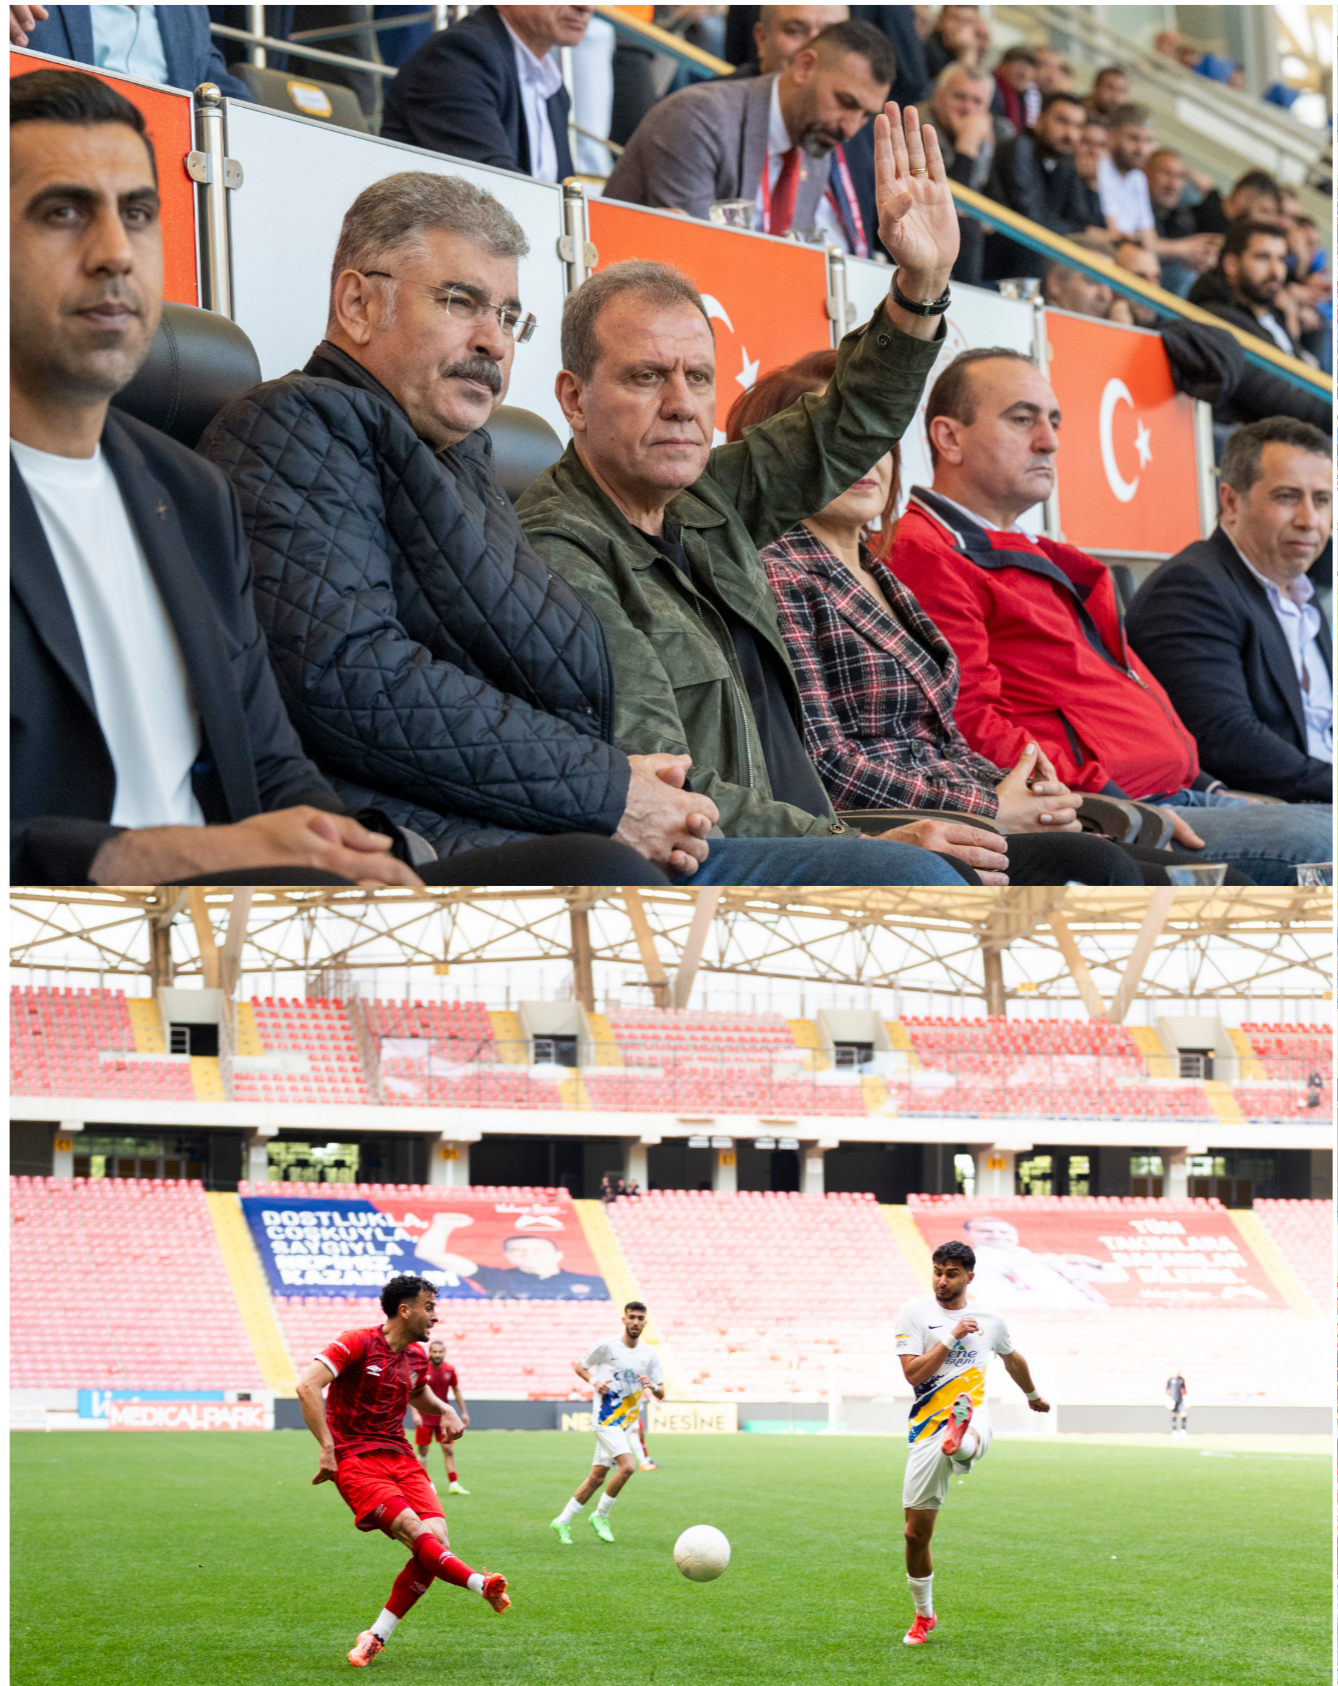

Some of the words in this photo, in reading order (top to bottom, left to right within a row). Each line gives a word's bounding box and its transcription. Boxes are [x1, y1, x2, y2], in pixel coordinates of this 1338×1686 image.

[261, 1210, 429, 1230] DOSTLUKLA,
[270, 1240, 405, 1257] SAYGIYLA
[653, 1409, 725, 1431] NESİNE
